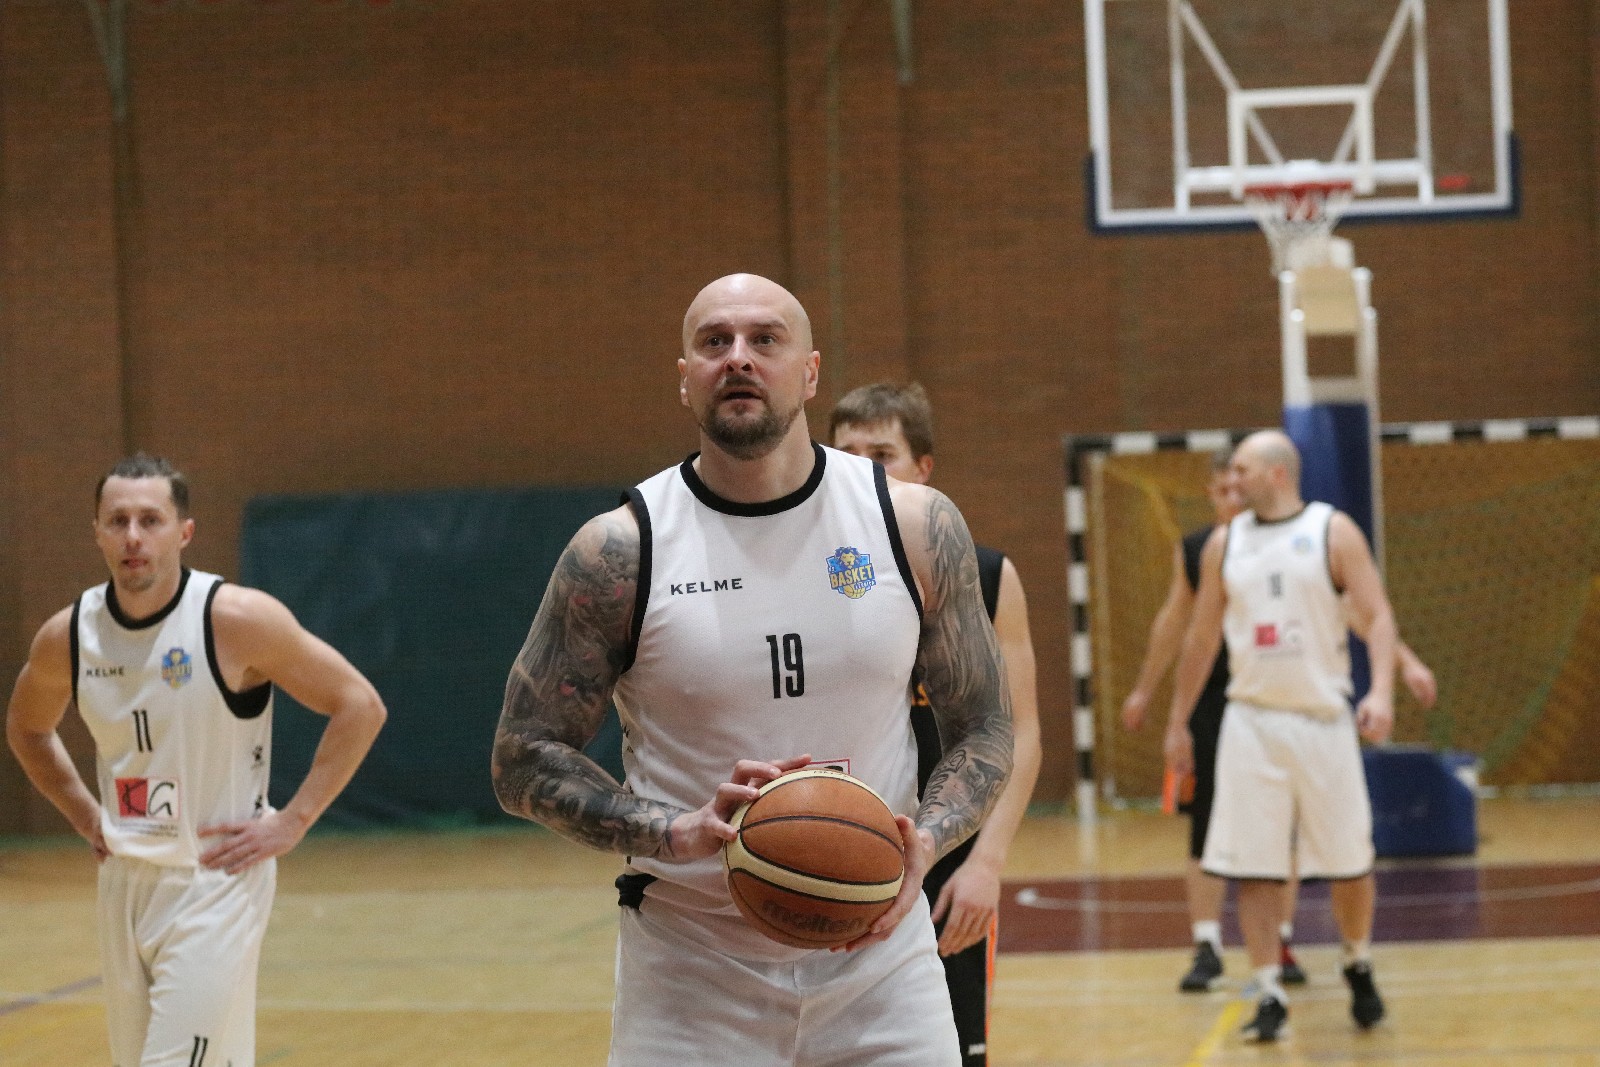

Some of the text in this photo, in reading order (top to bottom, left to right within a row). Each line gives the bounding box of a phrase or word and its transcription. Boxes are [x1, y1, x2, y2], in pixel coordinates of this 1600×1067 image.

[670, 578, 743, 596] KELME
[830, 563, 873, 588] BASKET
[766, 633, 804, 698] 19
[132, 710, 153, 752] 11
